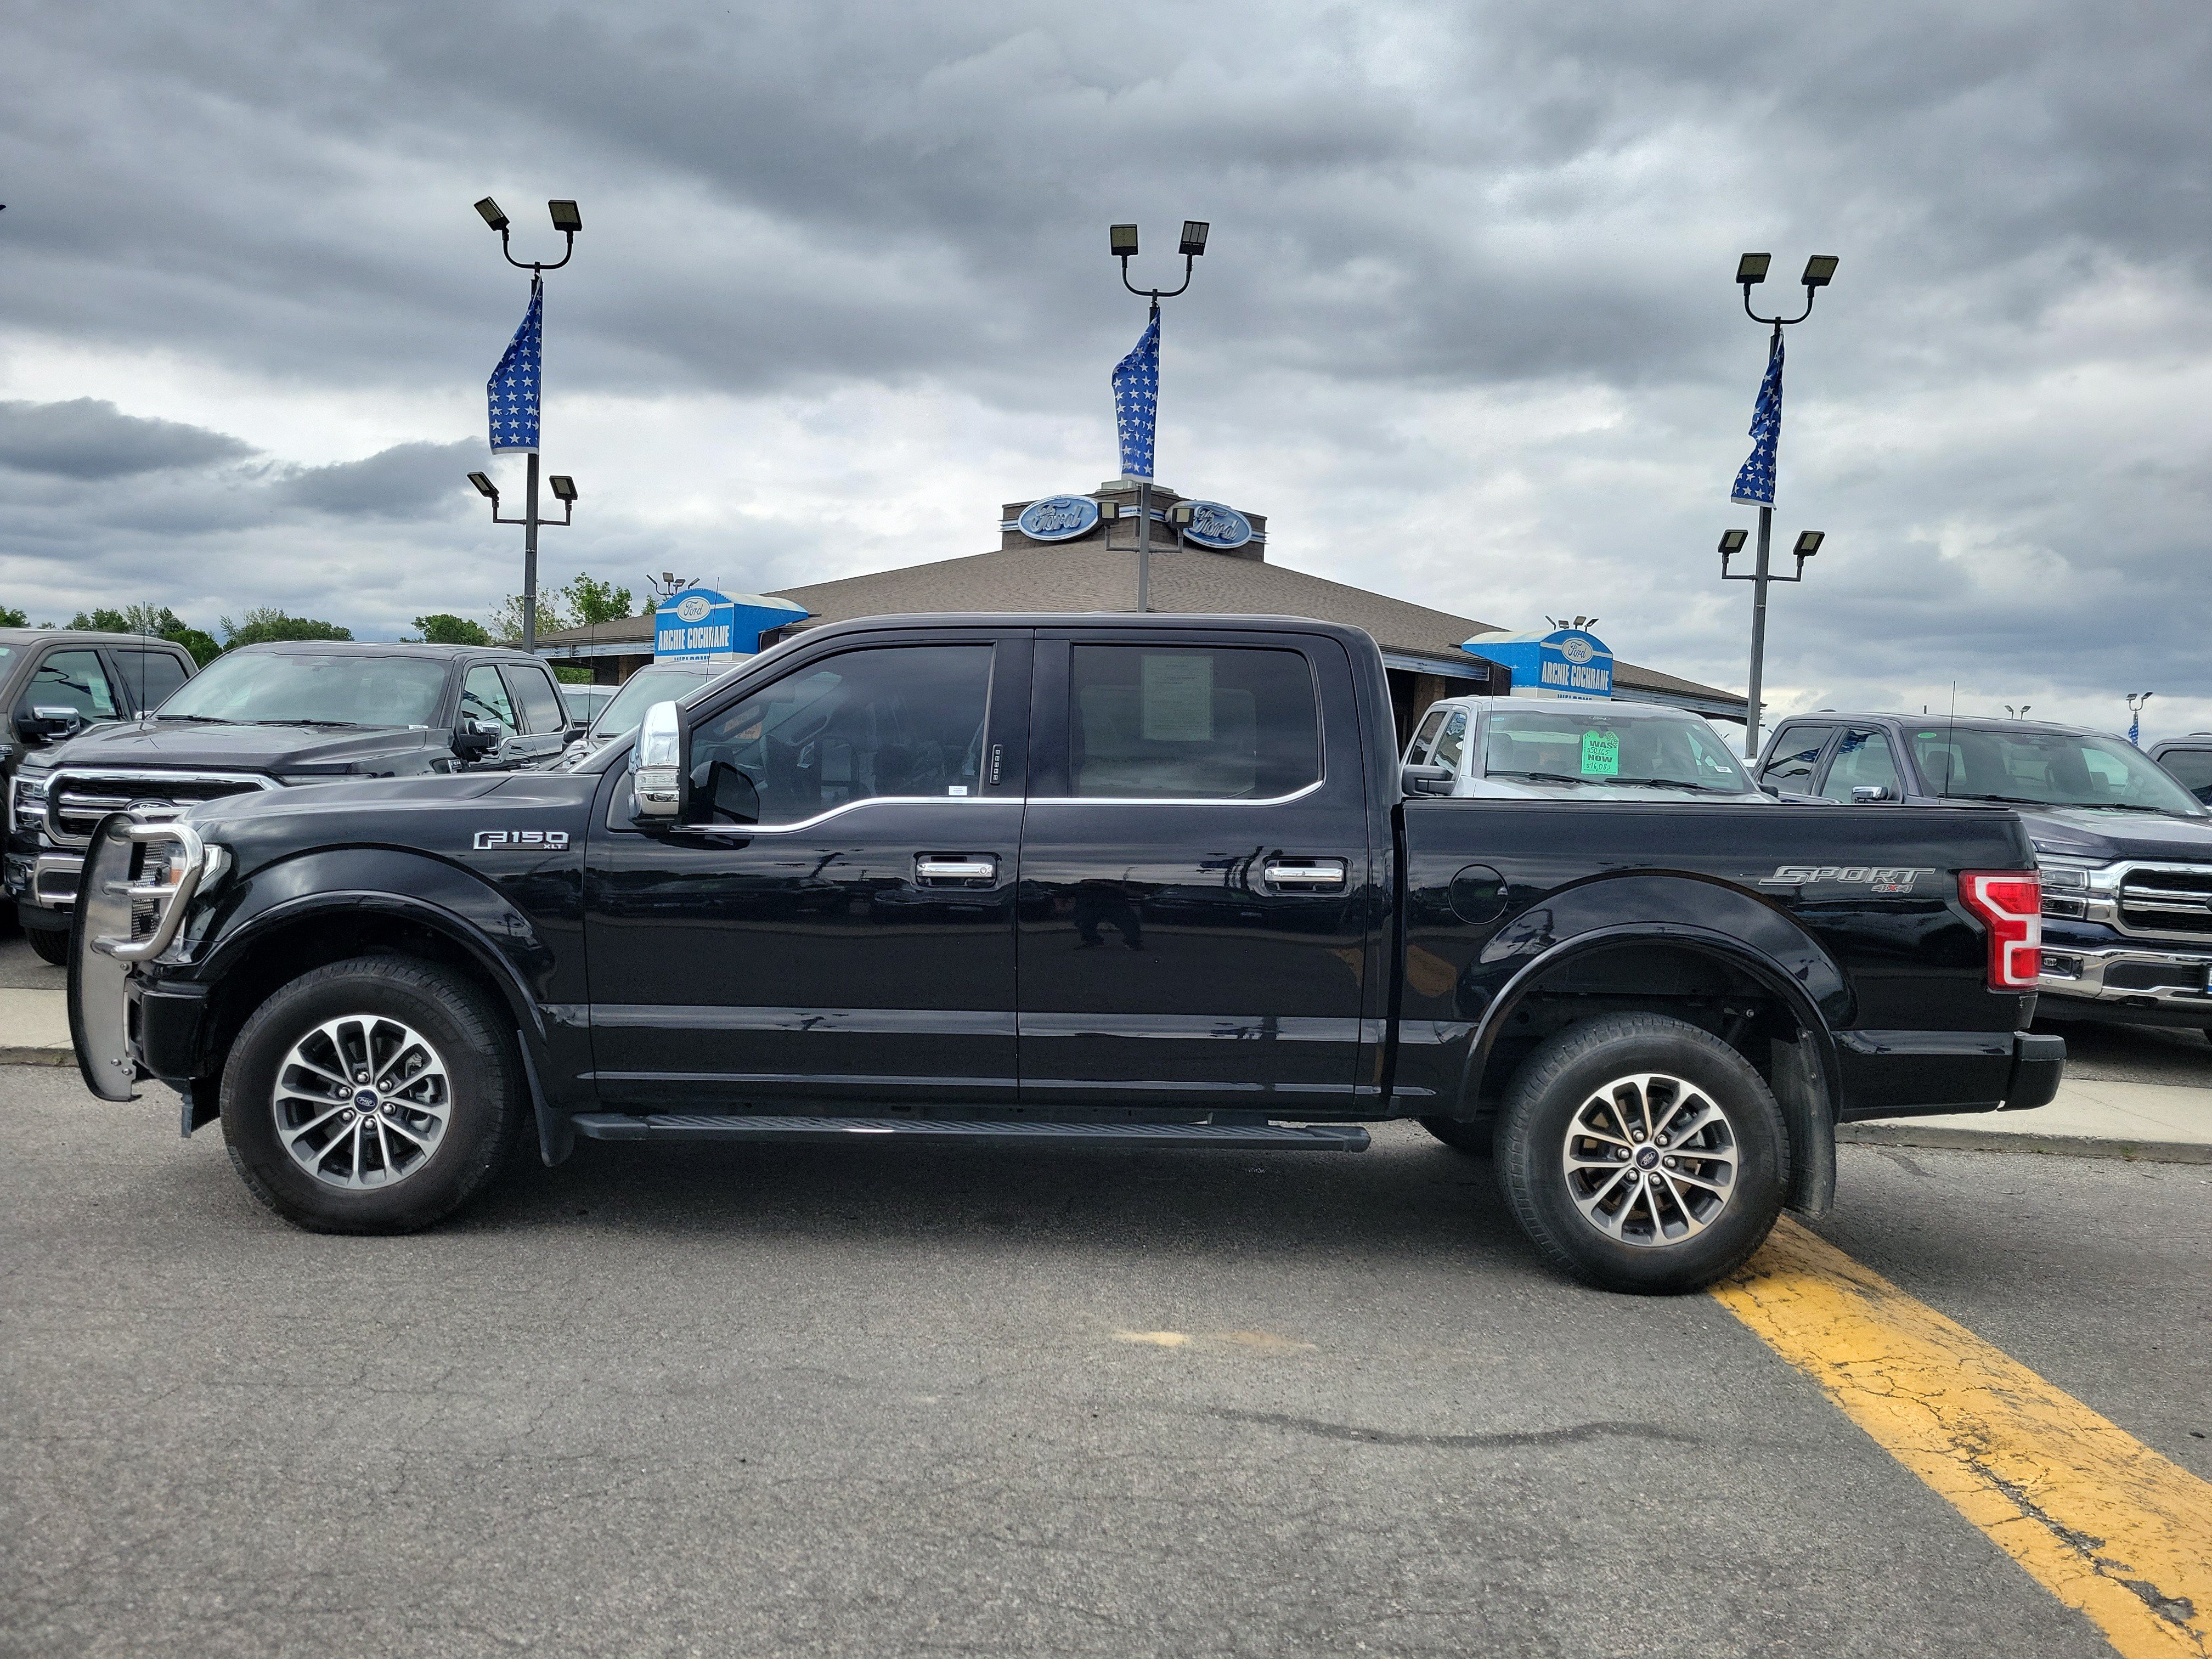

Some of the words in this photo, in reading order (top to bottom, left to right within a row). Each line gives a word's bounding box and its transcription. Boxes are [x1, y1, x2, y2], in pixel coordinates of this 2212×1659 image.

[1030, 500, 1084, 532] Ford
[1188, 505, 1239, 540] Ford
[684, 601, 703, 616] Ford
[658, 629, 685, 651] ARCHIE
[687, 625, 730, 649] COCHRANE
[1568, 641, 1587, 658] Ford
[1541, 661, 1570, 686] ARCHIE
[1571, 665, 1609, 691] COCHRANE
[1589, 740, 1613, 749] WAS
[1588, 754, 1613, 763] NOW
[1758, 866, 1937, 886] SPORT
